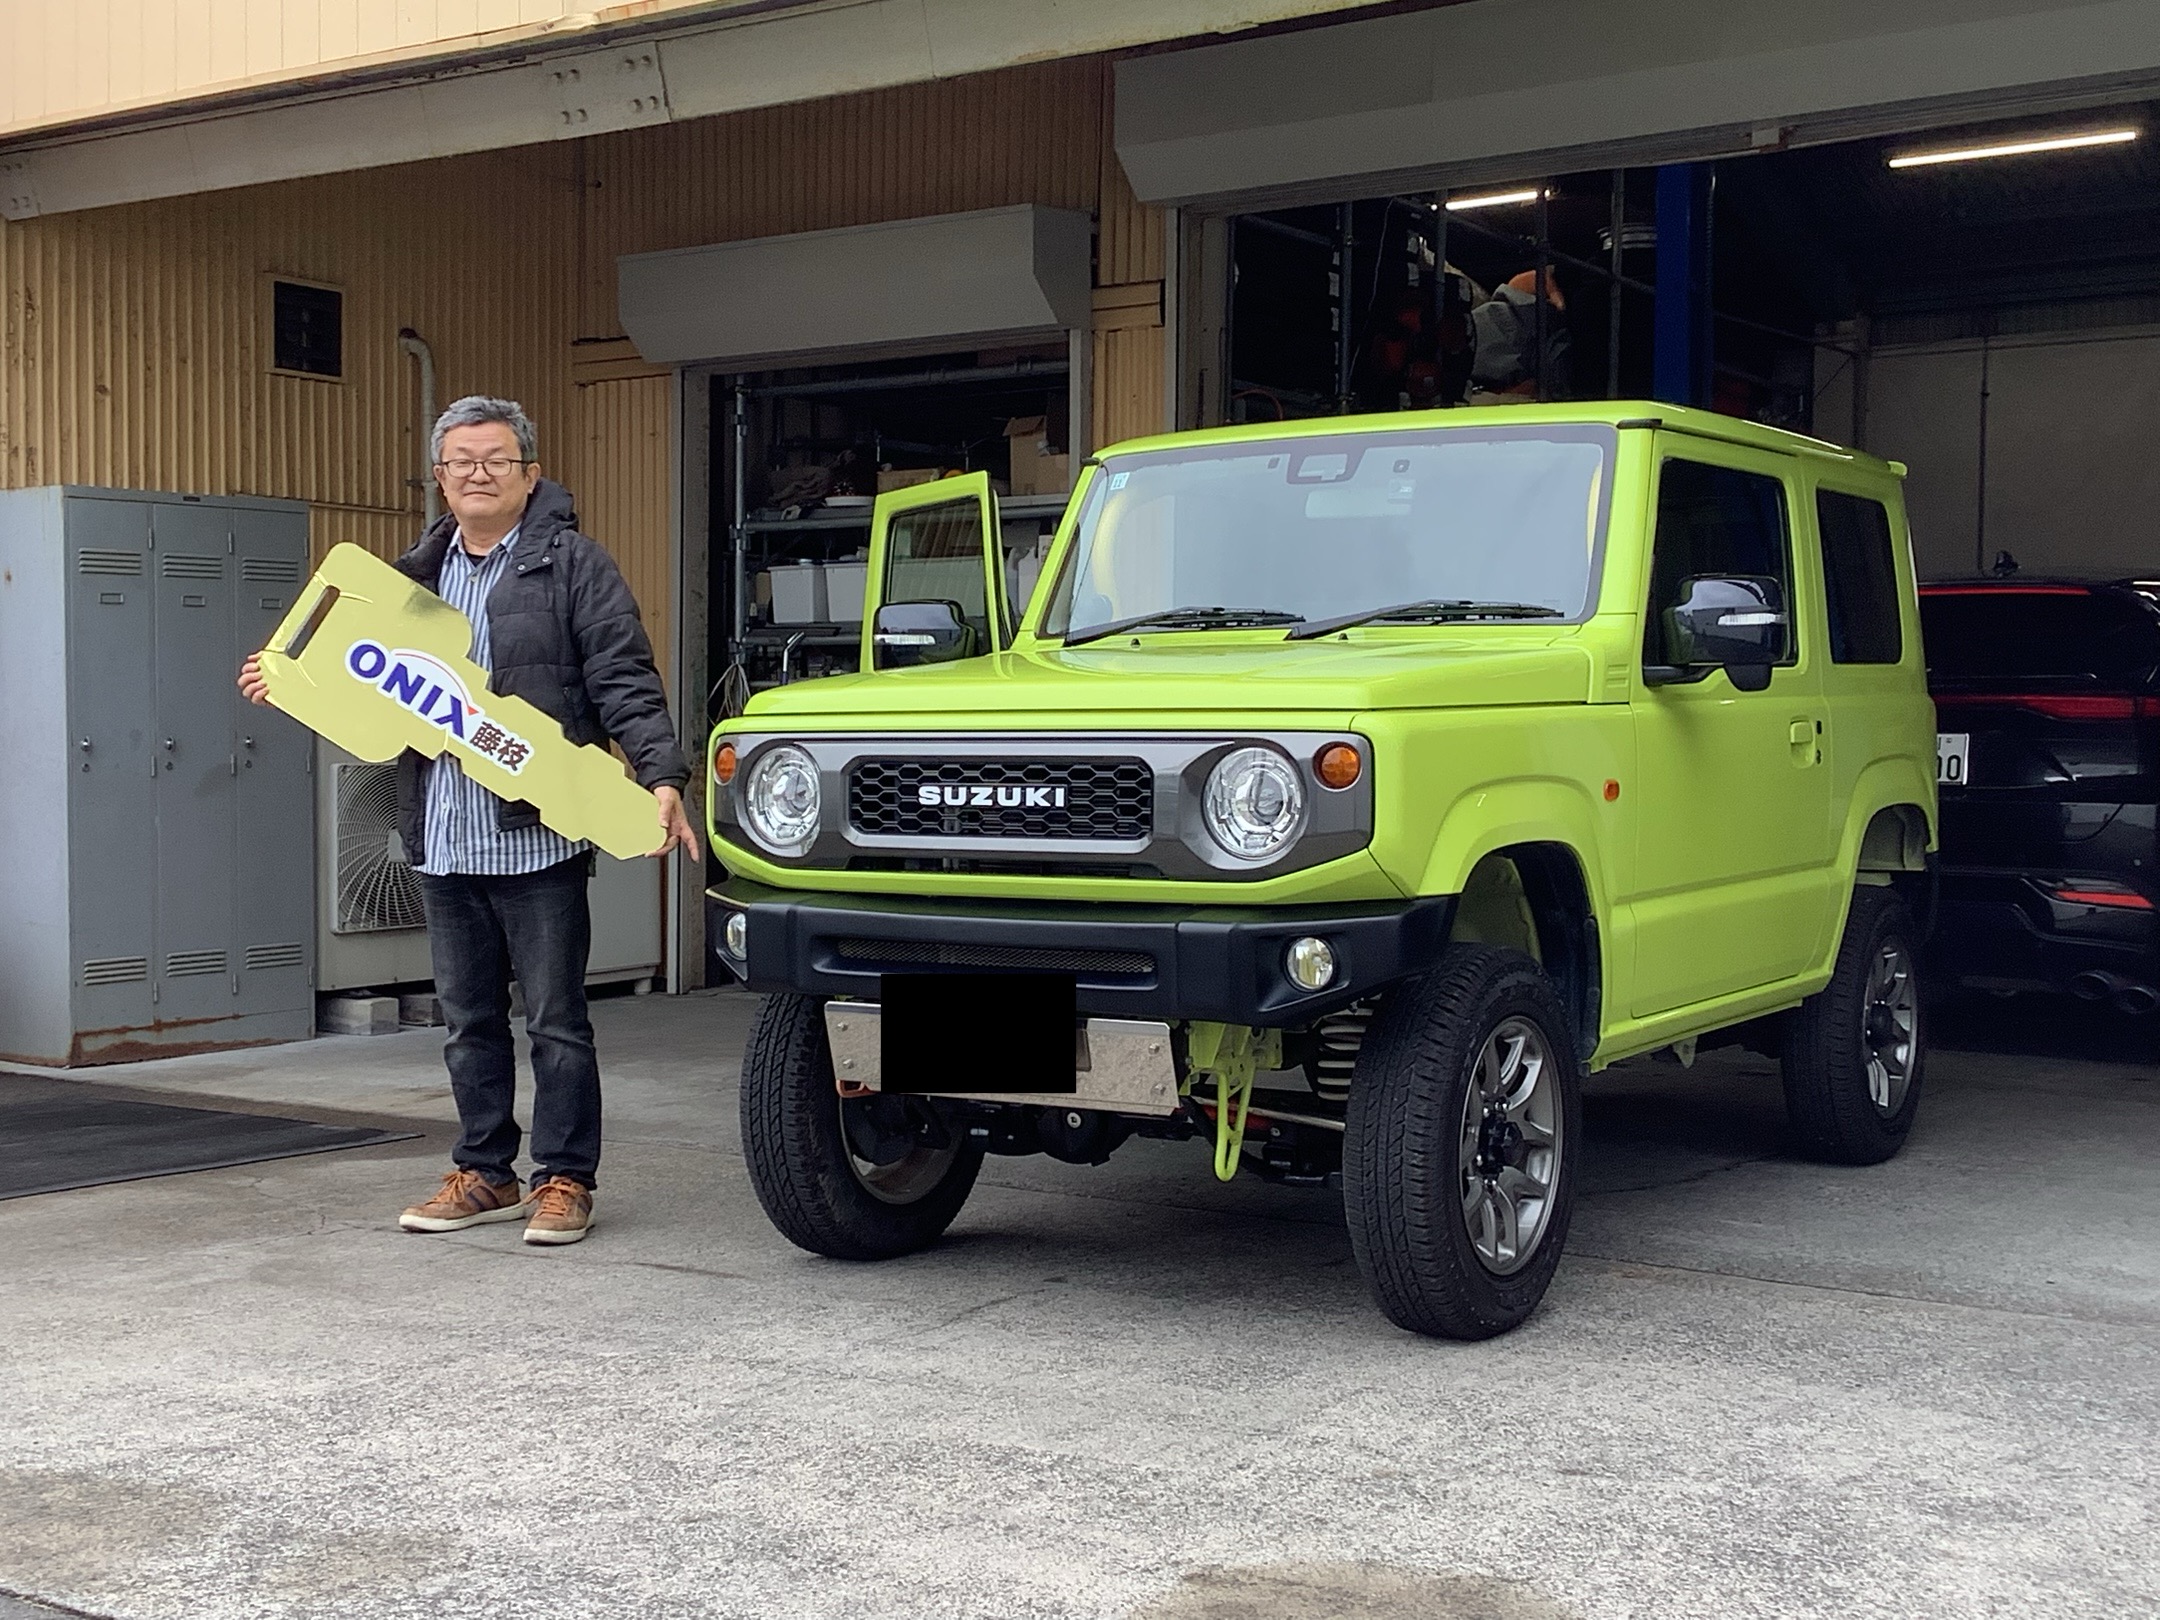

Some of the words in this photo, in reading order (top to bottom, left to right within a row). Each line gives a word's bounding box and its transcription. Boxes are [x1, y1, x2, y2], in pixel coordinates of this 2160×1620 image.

[350, 644, 465, 740] ONIX
[469, 721, 529, 771] 藤枝
[918, 786, 1065, 807] SUZUKI
